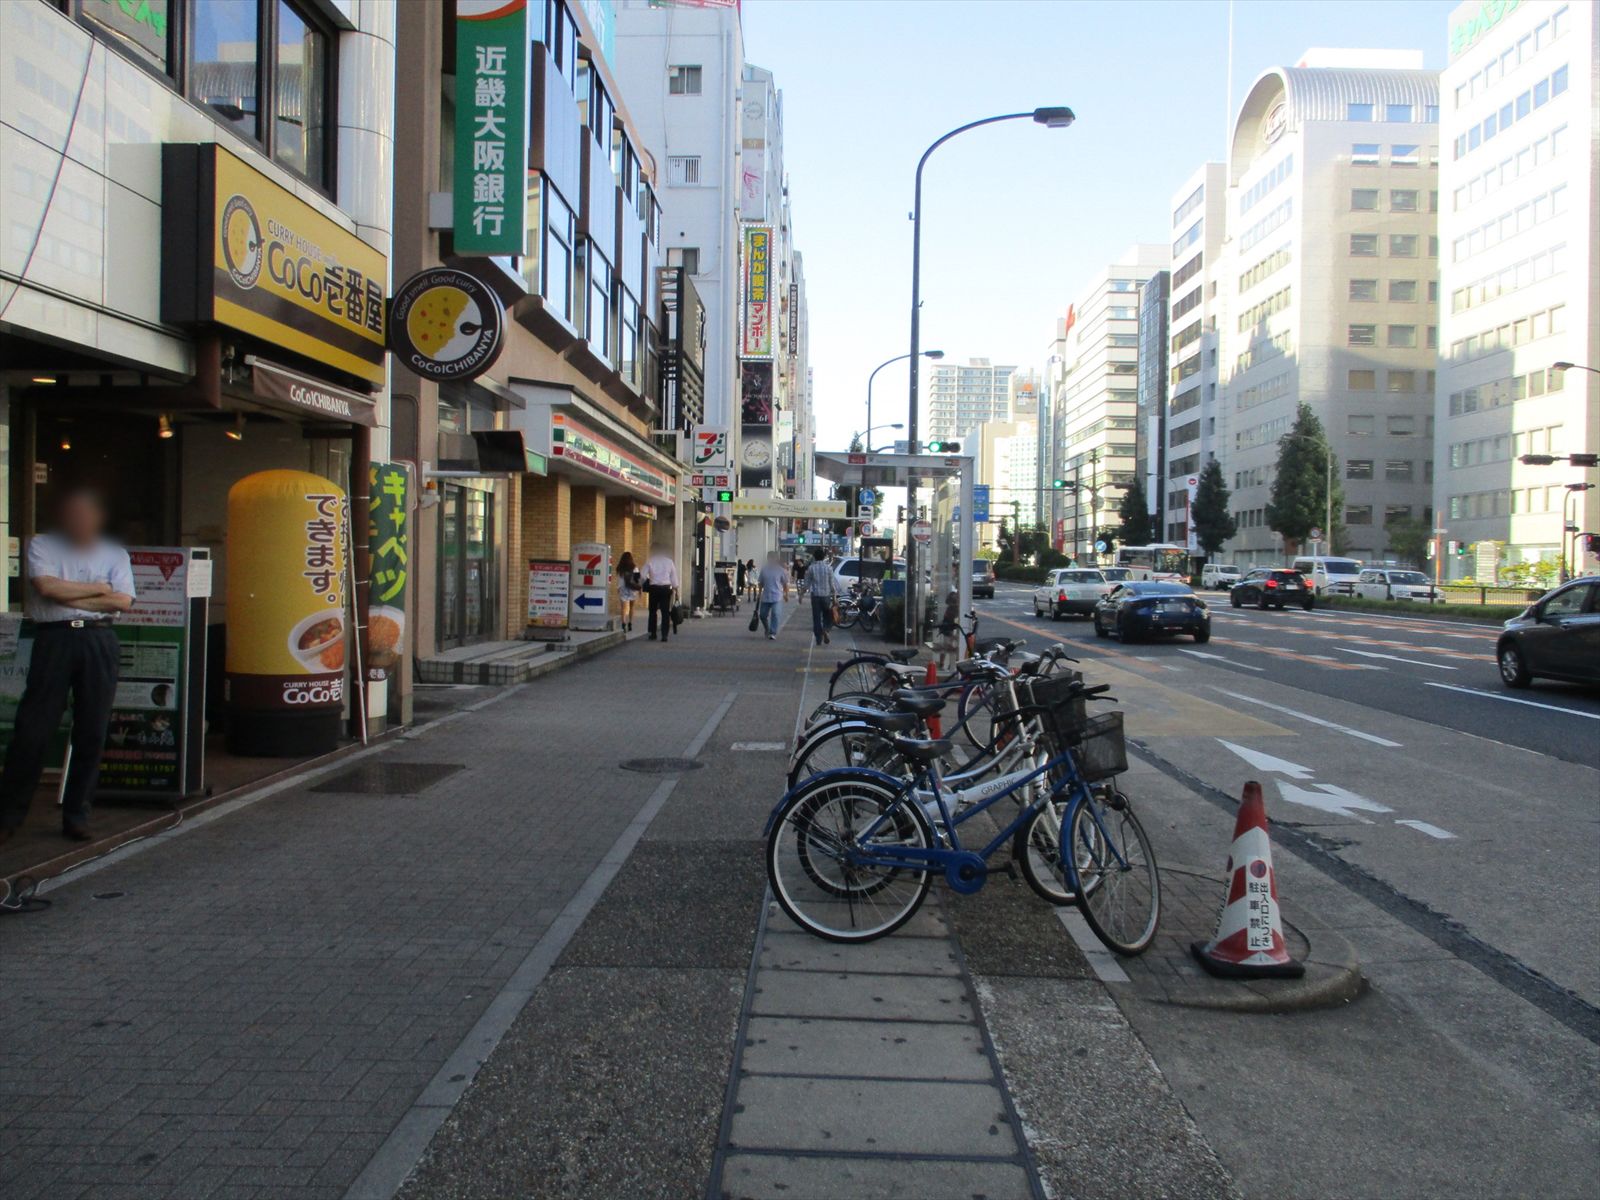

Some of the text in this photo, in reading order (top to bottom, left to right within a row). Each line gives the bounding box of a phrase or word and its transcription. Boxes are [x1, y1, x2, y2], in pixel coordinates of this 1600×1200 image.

[473, 45, 507, 236] 近畿大阪銀行
[267, 219, 295, 245] CURRY
[296, 236, 321, 261] HOUSE
[411, 328, 494, 374] CoCoICHIBANYA
[290, 384, 352, 417] CoCoICHIBANYA
[304, 494, 337, 604] できます。
[374, 470, 407, 603] キャベツ
[283, 680, 330, 689] CURRY HOUSE
[1248, 881, 1262, 948] 駐車禁止
[1259, 881, 1270, 947] 出入口につき
